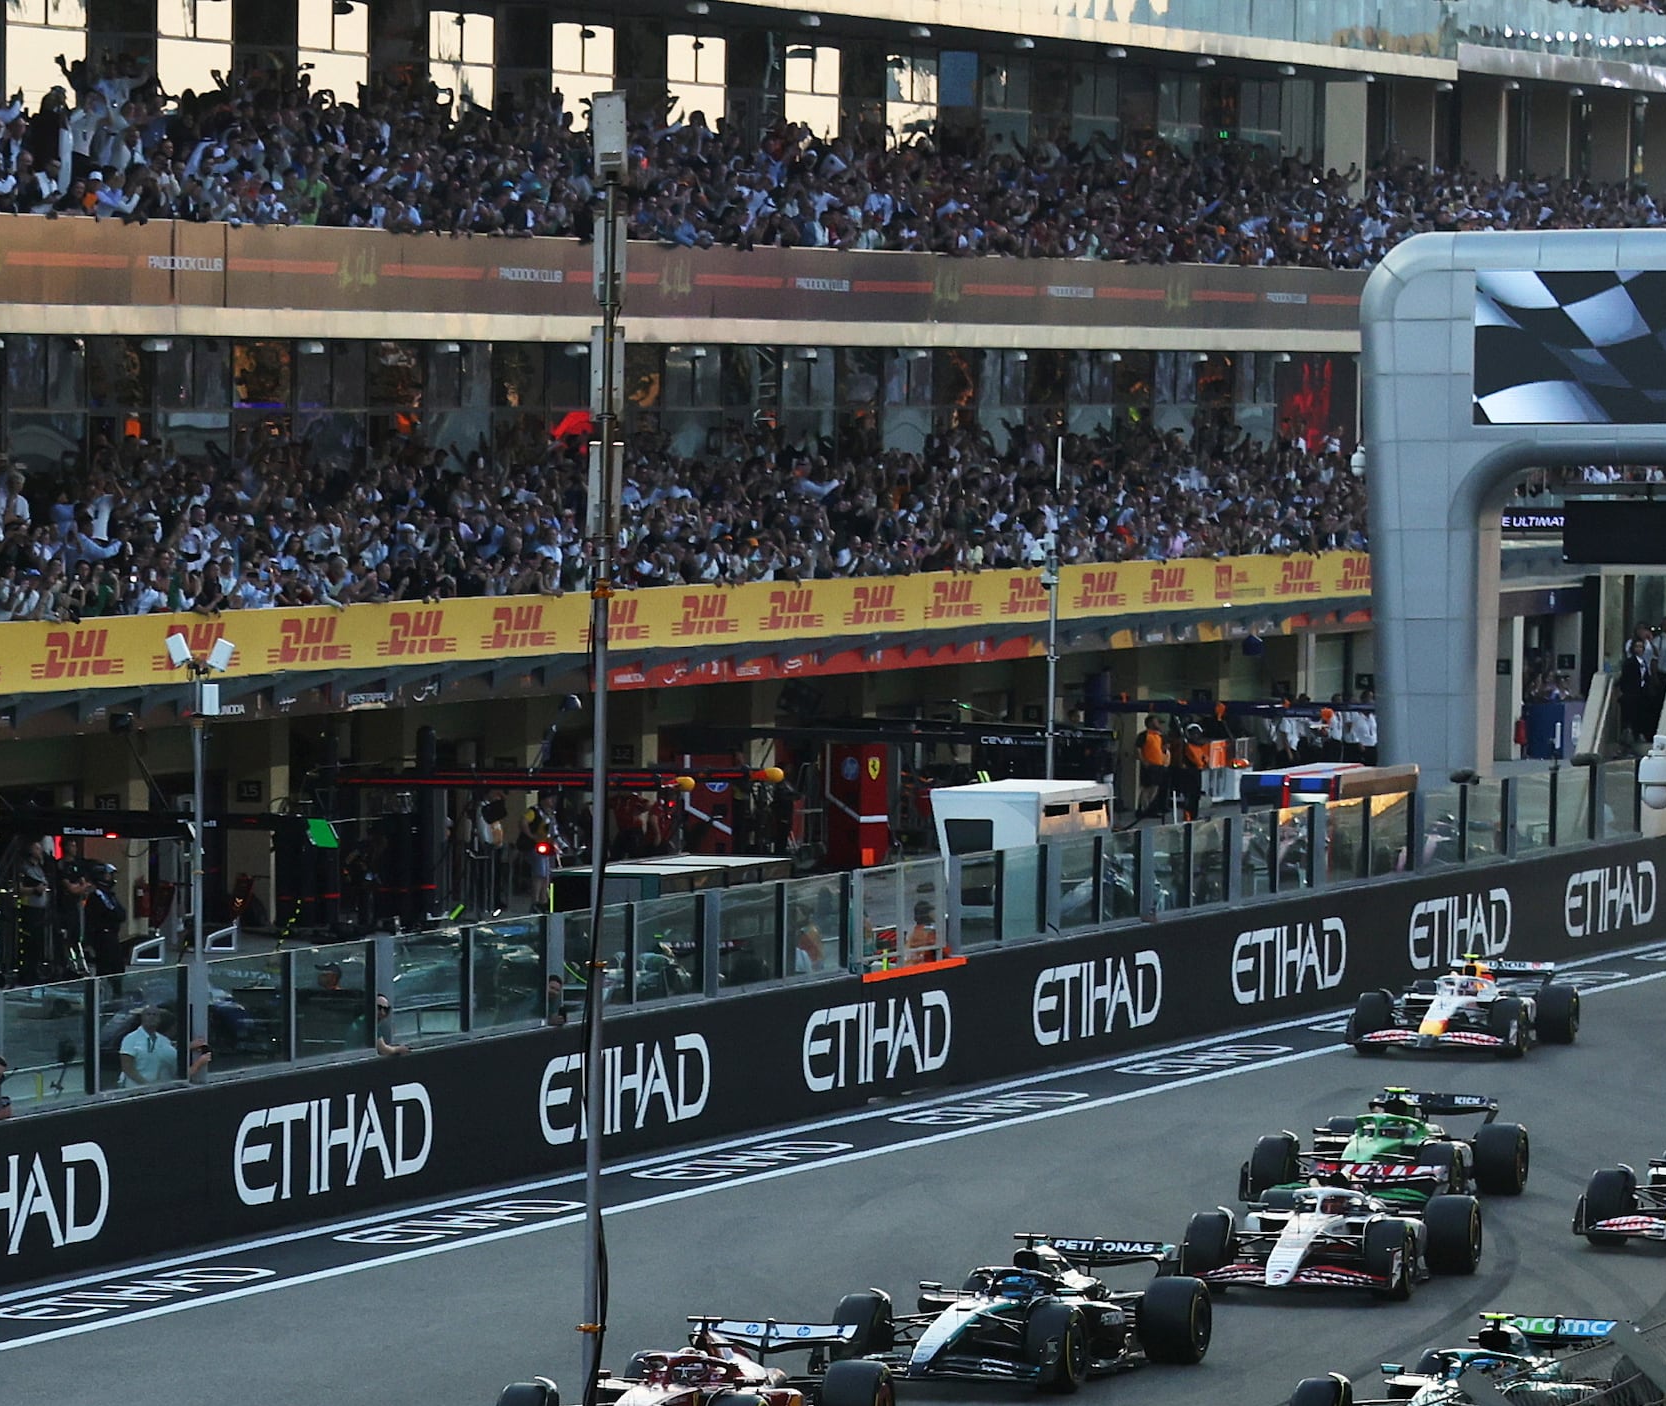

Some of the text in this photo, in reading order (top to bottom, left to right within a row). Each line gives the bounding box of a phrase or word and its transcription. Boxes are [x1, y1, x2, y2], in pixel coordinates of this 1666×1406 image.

[148, 255, 223, 271] PADDOCK CLUB
[1512, 516, 1566, 528] ULTIMAT
[1007, 577, 1050, 614] DHL
[1080, 572, 1121, 608] DHL
[1149, 568, 1187, 604] DHL
[1281, 561, 1316, 595] DHL
[679, 594, 730, 635] DHL
[767, 590, 815, 630] DHL
[852, 585, 897, 626] DHL
[931, 580, 975, 619] DHL
[279, 616, 341, 663] DHL
[388, 611, 447, 656] DHL
[491, 605, 546, 649] DHL
[44, 630, 112, 679] DHL
[1564, 860, 1657, 937] ETIHAD
[1409, 887, 1512, 971] ETIHAD
[1232, 916, 1347, 1004] ETIHAD
[1488, 961, 1528, 970] UDOR
[1033, 950, 1162, 1046] ETIHAD
[803, 990, 952, 1092] ETIHAD
[889, 1090, 1089, 1126] ETIHAD
[1454, 1095, 1481, 1105] KICK
[235, 1083, 432, 1205] ETIHAD
[631, 1140, 854, 1180] ETIHAD
[333, 1200, 588, 1245] ETIHAD
